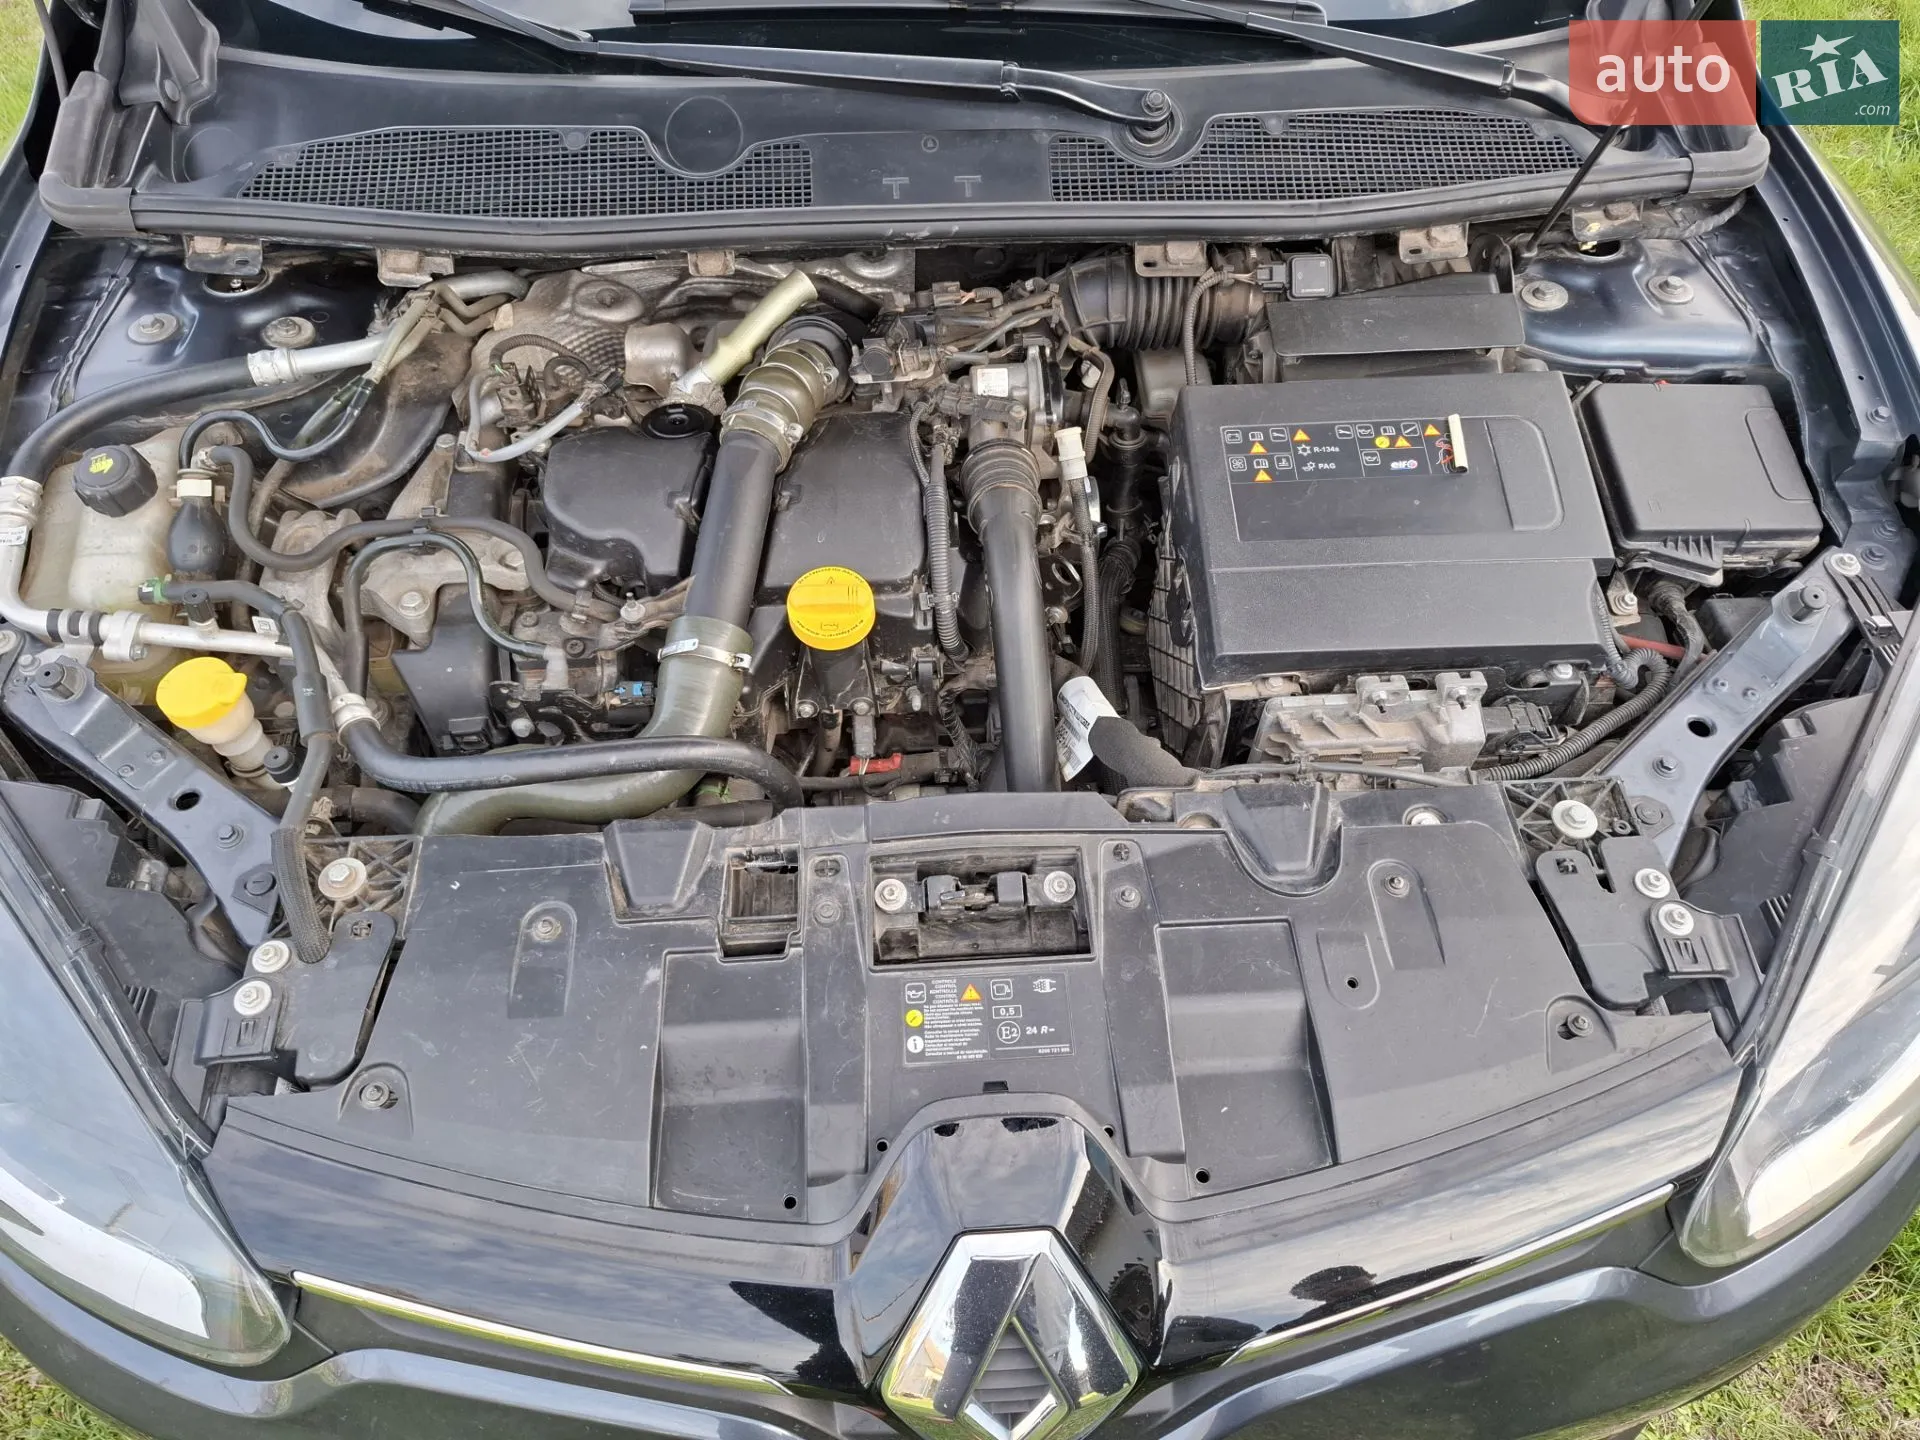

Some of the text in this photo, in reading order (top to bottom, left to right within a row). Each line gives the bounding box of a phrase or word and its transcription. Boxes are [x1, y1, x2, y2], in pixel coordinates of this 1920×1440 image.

[1318, 462, 1336, 470] PAG
[1000, 1007, 1015, 1017] 0,5
[1000, 1026, 1018, 1040] E2
[1026, 1026, 1037, 1035] 24
